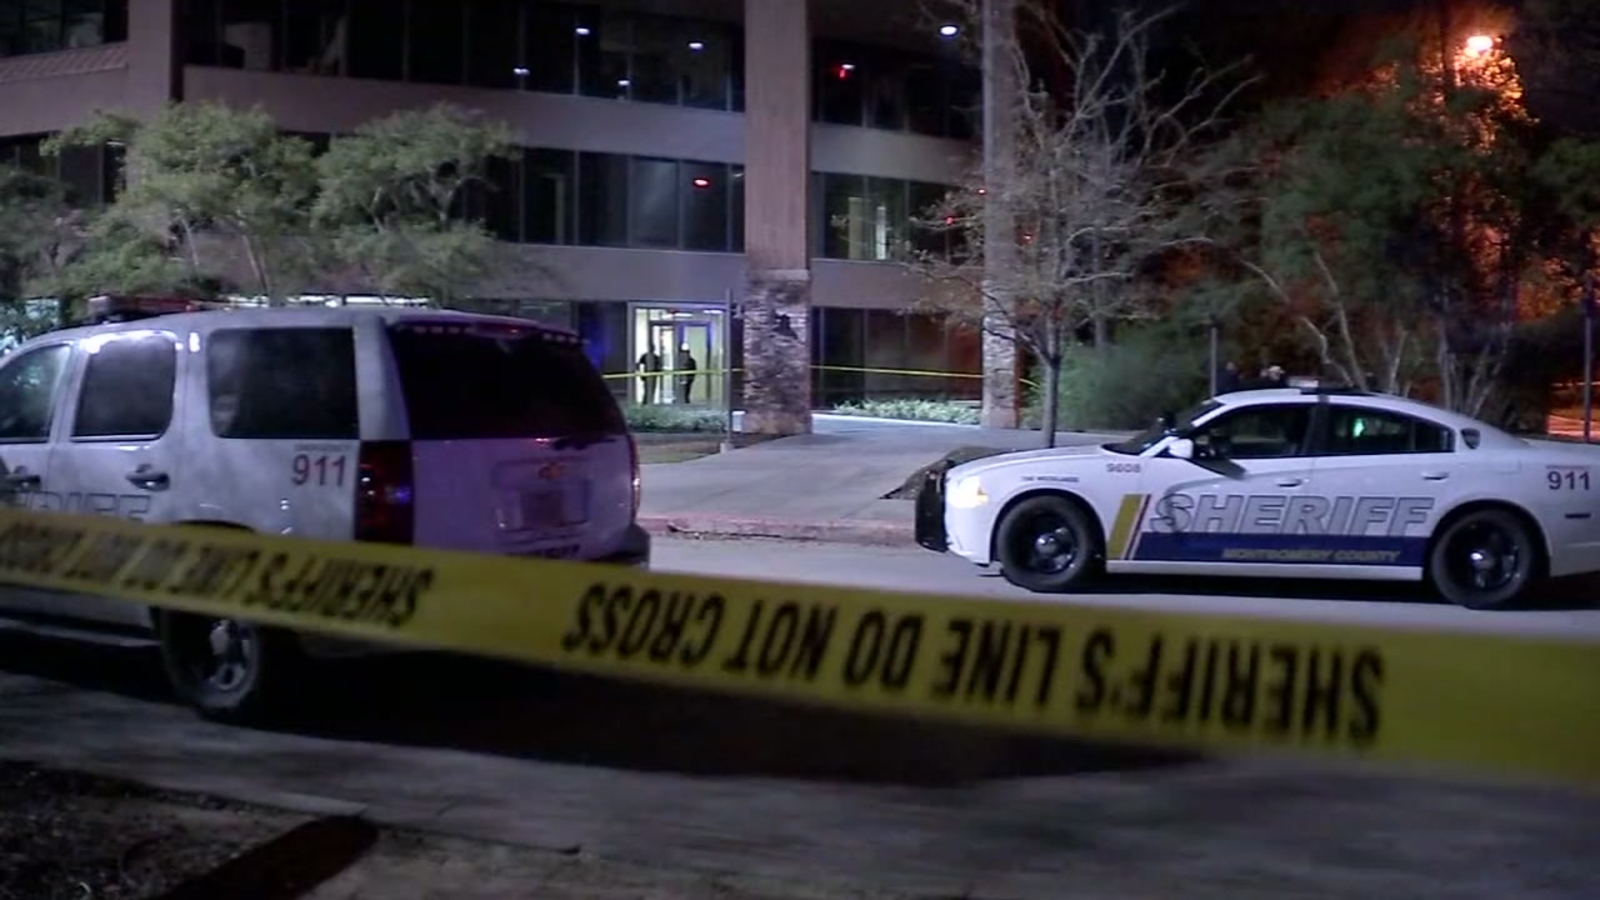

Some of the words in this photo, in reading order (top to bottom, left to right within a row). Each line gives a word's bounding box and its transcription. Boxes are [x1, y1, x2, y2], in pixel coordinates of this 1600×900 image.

[291, 453, 347, 487] 911
[1546, 470, 1591, 491] 911
[1149, 492, 1435, 538] SHERIFF
[561, 582, 728, 669] CROSS
[720, 598, 839, 682] NOT
[841, 610, 926, 693] DO
[931, 614, 1063, 708] LINE
[1075, 626, 1386, 743] SHERIFF'S
